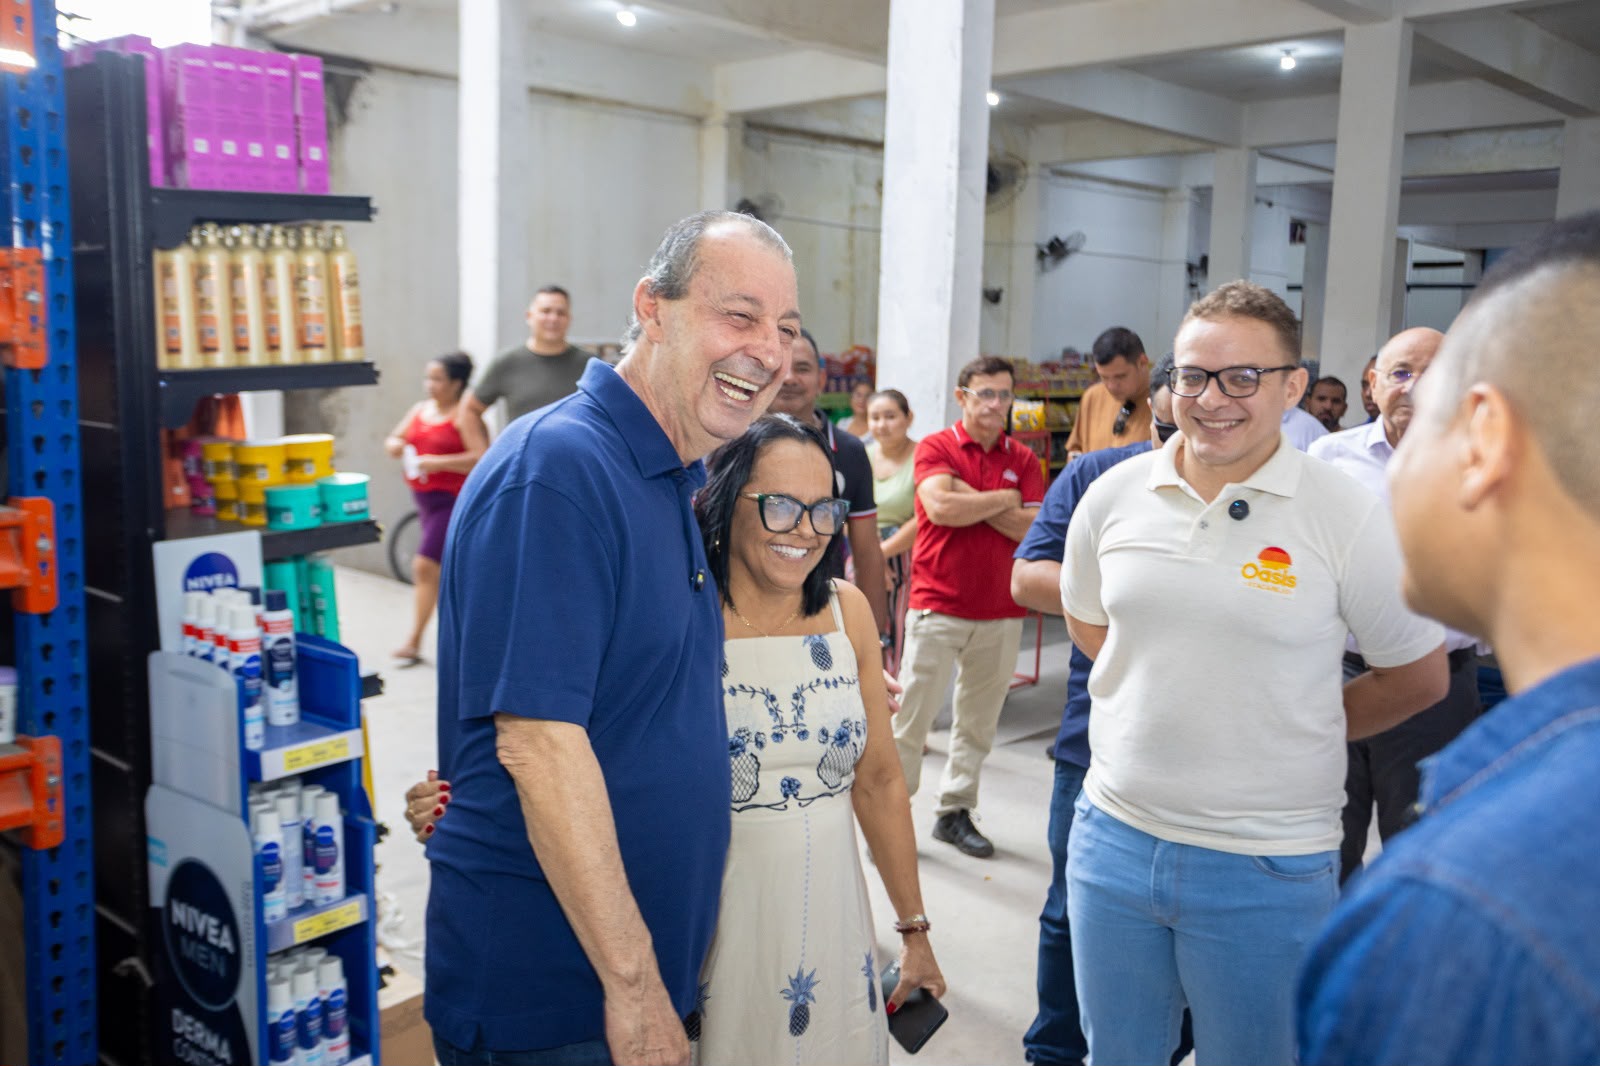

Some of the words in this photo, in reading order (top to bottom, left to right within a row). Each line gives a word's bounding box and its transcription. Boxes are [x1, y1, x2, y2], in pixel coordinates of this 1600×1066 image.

[186, 572, 236, 590] NIVEA
[1241, 562, 1297, 588] Oasis
[171, 899, 235, 954] NIVEA
[180, 935, 226, 977] MEN
[171, 1007, 232, 1064] DERMA
